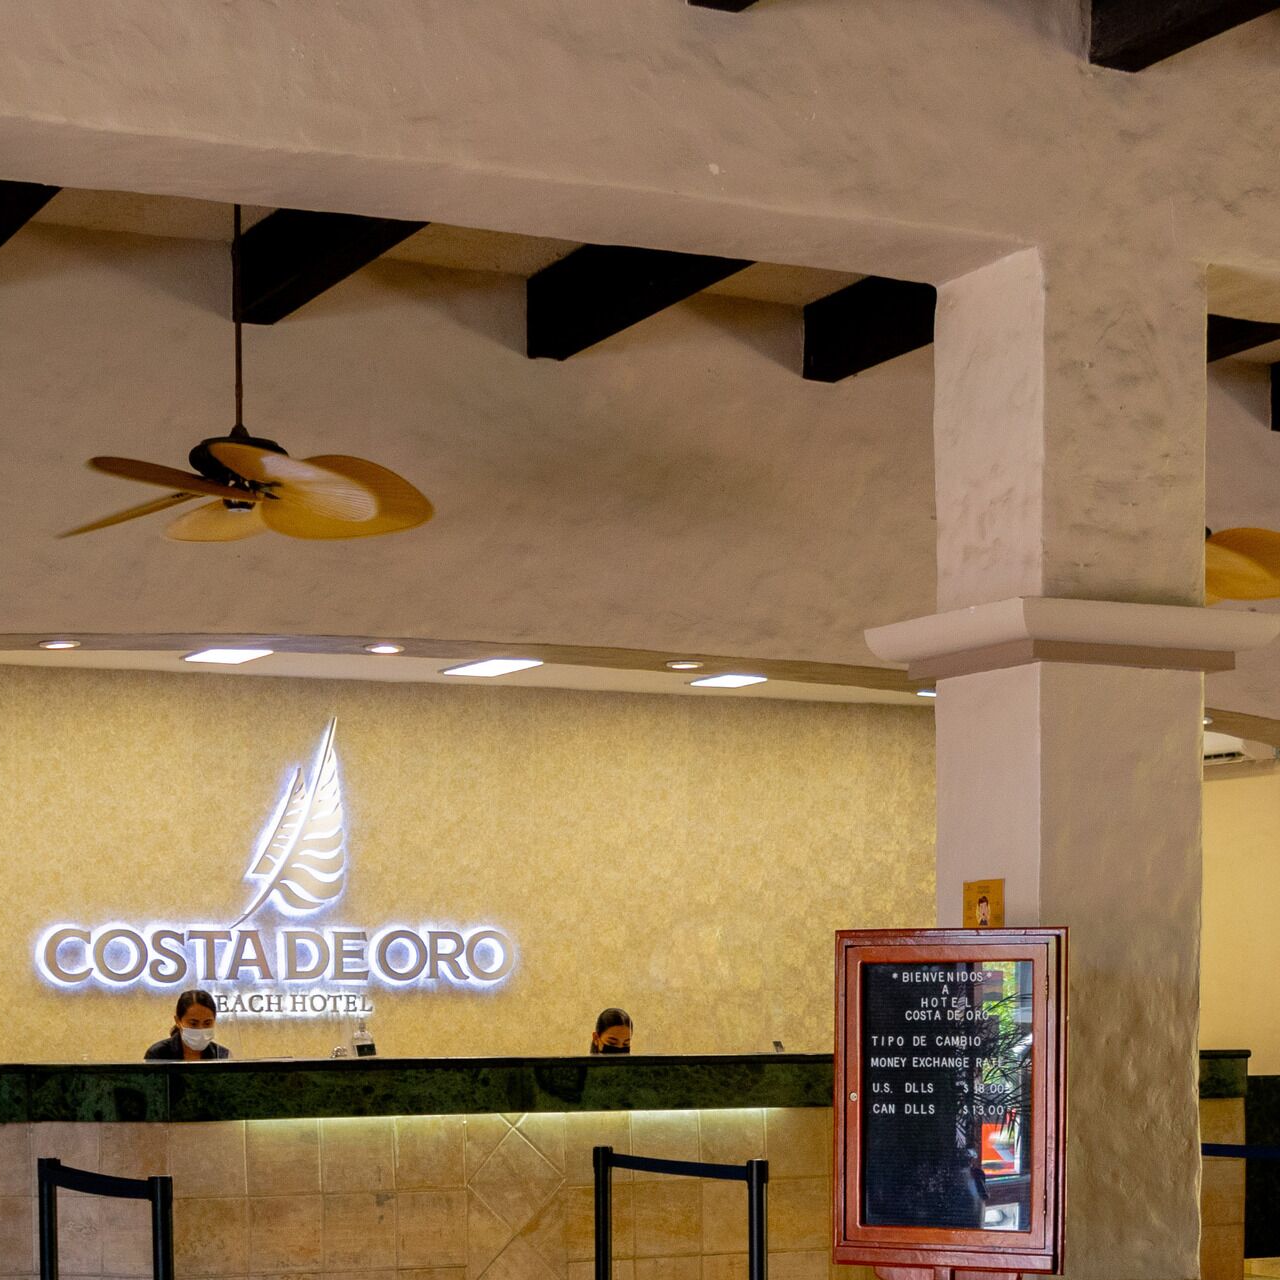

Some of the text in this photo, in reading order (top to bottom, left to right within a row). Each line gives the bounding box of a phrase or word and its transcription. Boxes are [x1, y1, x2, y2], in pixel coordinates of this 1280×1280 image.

[43, 927, 515, 984] COSTA DE ORO
[941, 984, 950, 995] A
[214, 993, 374, 1013] EACH HOTEL
[920, 997, 972, 1008] HOTEL
[904, 1009, 990, 1021] COSTA DE ORO
[871, 1035, 982, 1047] TIPO DE CAMBIO
[870, 1056, 907, 1068] MONEY
[912, 1056, 970, 1068] EXCHANGE
[872, 1082, 894, 1094] U.S.
[904, 1082, 934, 1094] DLLS
[872, 1103, 896, 1115] CAN
[904, 1103, 936, 1115] DLLS
